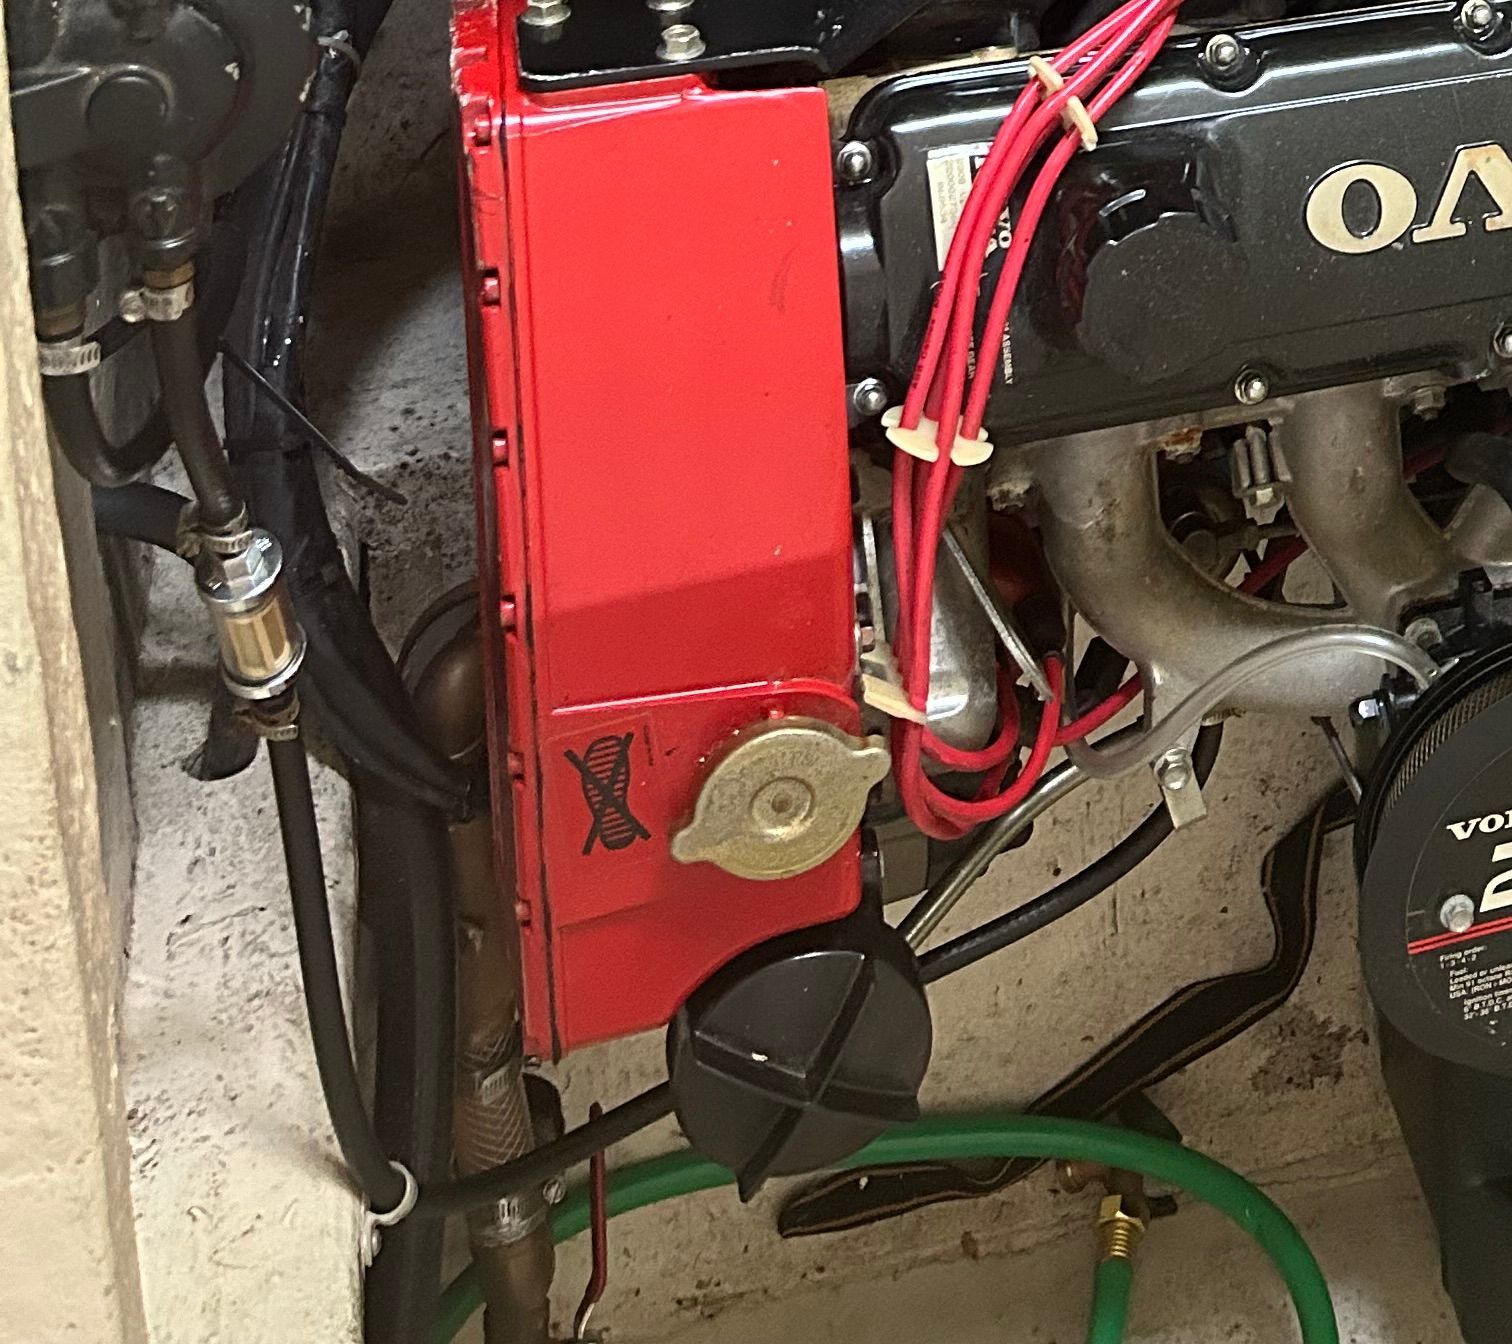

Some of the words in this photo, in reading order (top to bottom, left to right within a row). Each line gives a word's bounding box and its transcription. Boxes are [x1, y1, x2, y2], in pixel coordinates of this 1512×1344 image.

[1002, 333, 1013, 385] ASSEMBLY
[1440, 952, 1462, 962] Firing
[1477, 973, 1503, 984] octane
